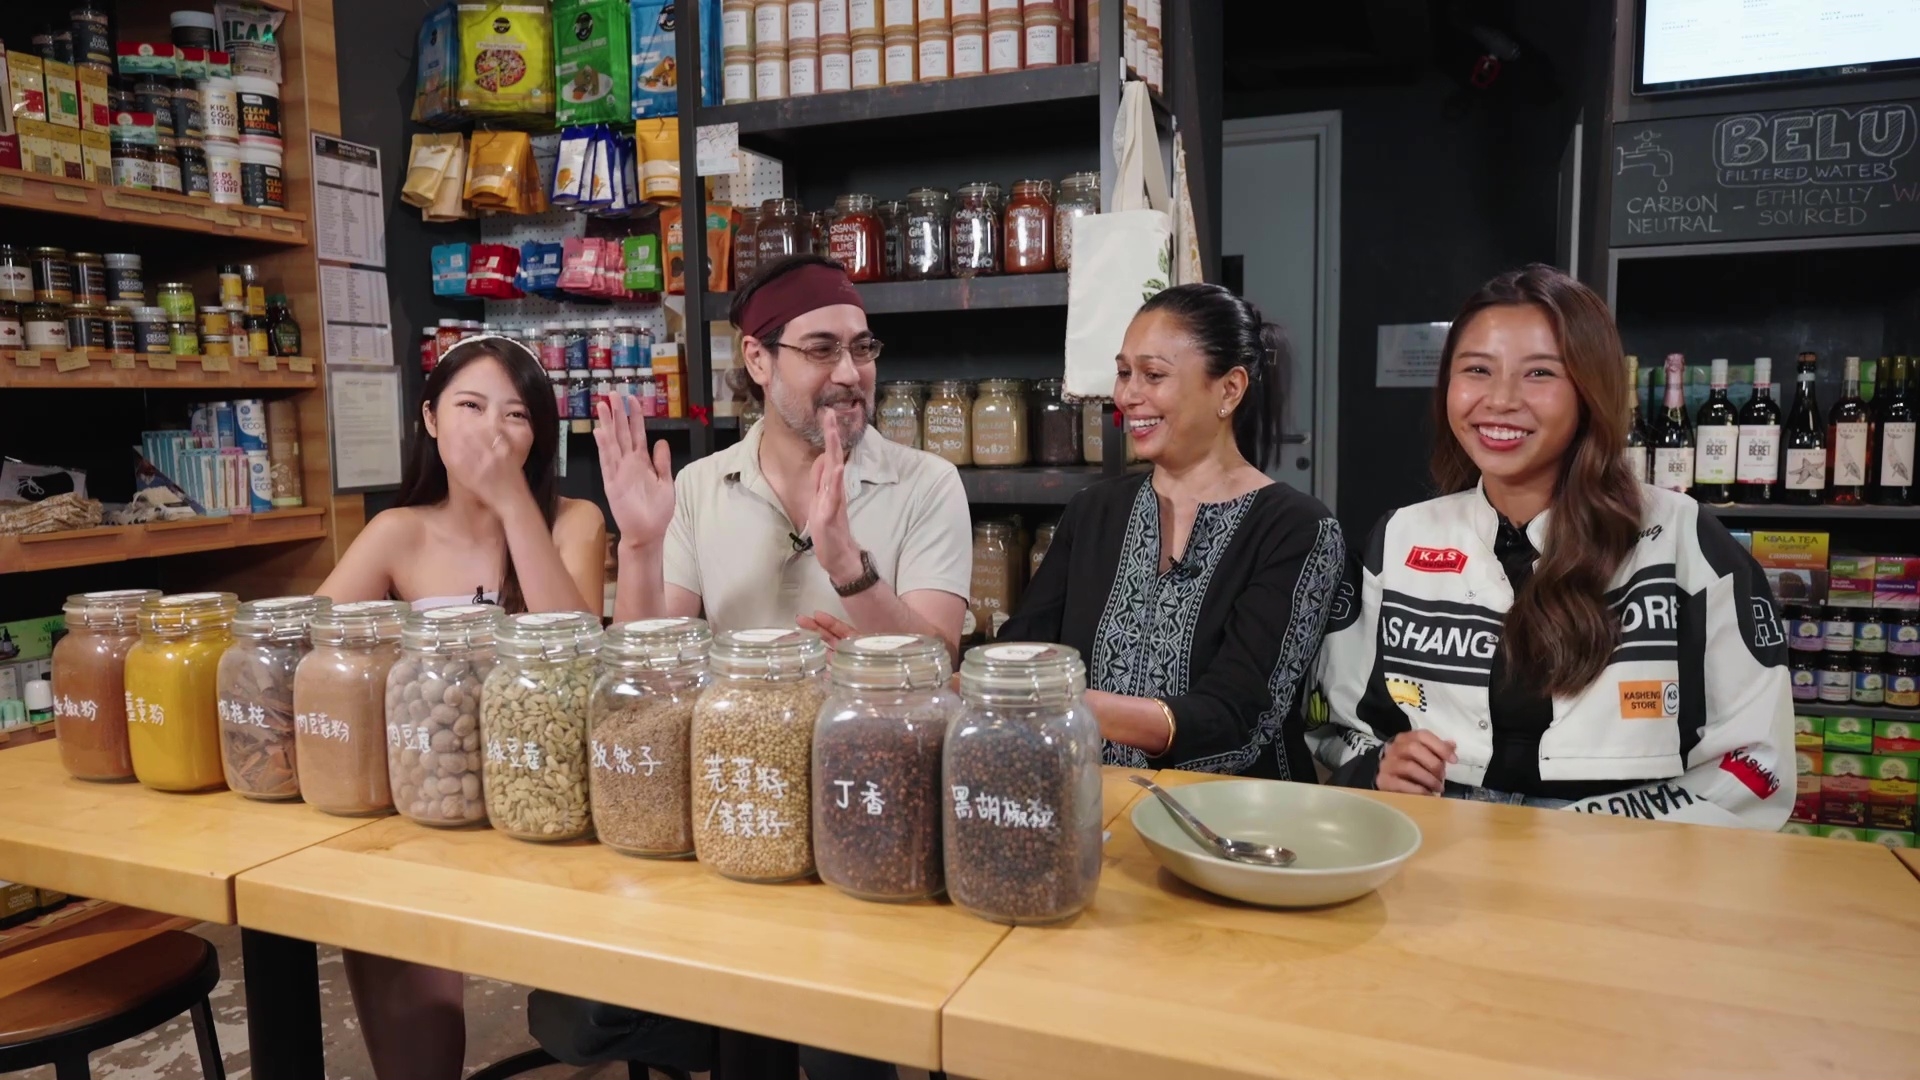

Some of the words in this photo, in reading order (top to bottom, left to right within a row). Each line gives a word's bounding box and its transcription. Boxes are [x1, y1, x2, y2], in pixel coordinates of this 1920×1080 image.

[222, 20, 276, 45] CAA
[210, 104, 230, 113] KIDS
[242, 106, 270, 115] CLEAN
[210, 111, 236, 121] GOOD
[243, 113, 265, 122] LEAN
[211, 118, 235, 128] STUFF
[244, 120, 277, 131] PROTEIN
[1721, 109, 1906, 167] BELU
[1725, 167, 1808, 181] FILTERED
[1815, 162, 1889, 178] WATER
[1755, 186, 1874, 207] ETHICALLY
[1627, 193, 1718, 215] CARBON
[1758, 207, 1868, 226] SOURCED
[1628, 213, 1723, 235] NEUTRAL
[837, 242, 855, 252] LIME
[928, 415, 964, 426] CHICKEN
[1799, 535, 1818, 545] TEA
[1748, 596, 1784, 648] R
[1624, 691, 1661, 700] KASHENG
[1667, 691, 1678, 700] KS
[1631, 701, 1657, 710] STORE
[833, 780, 886, 816] 丁香
